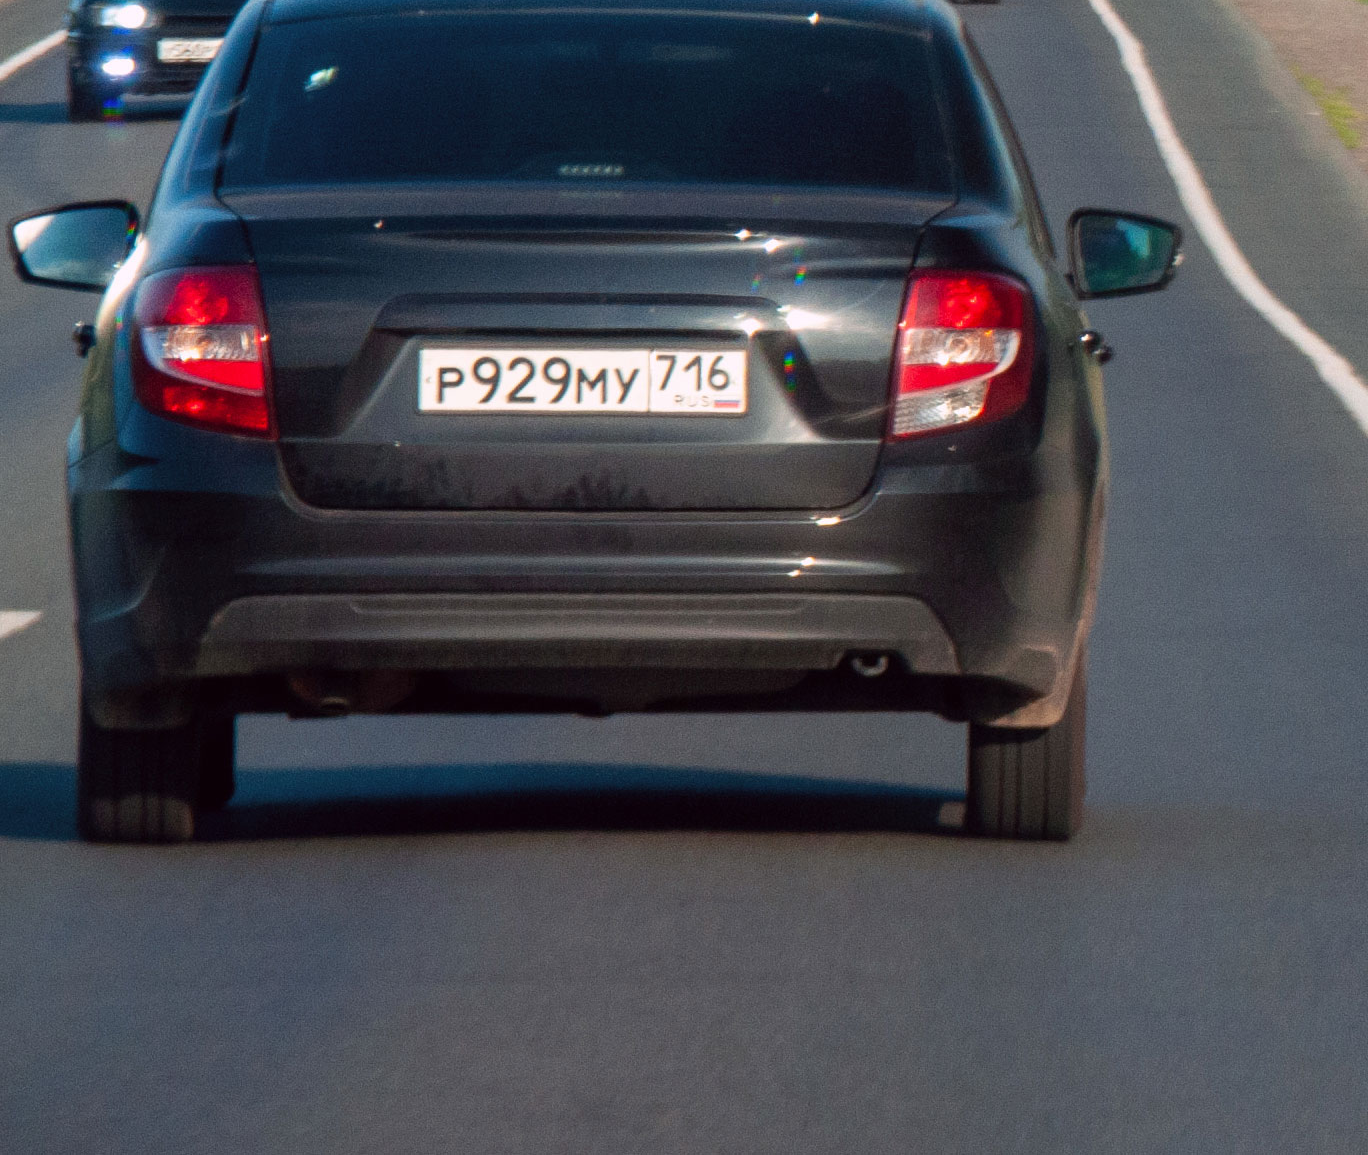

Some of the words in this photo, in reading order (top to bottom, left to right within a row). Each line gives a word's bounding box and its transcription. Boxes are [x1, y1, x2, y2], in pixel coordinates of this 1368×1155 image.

[436, 356, 640, 404] Р929МУ
[655, 354, 731, 392] 716
[674, 394, 711, 408] RUS
